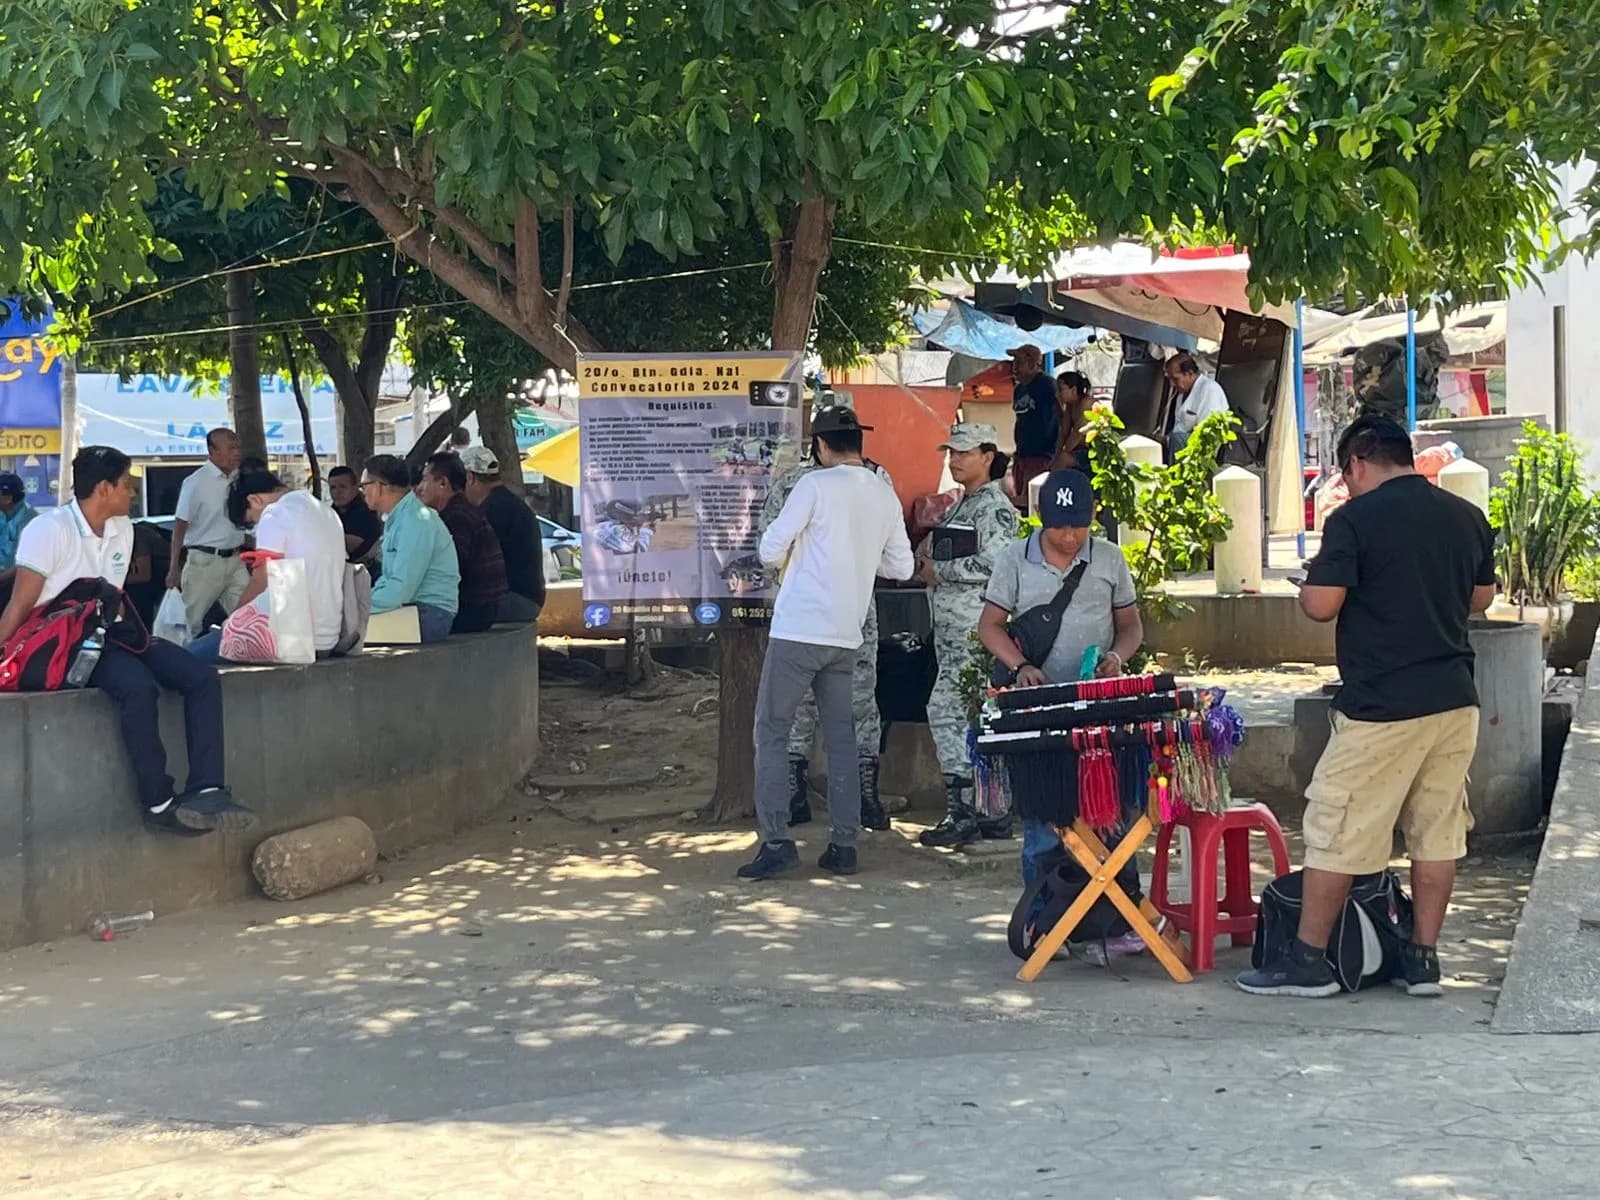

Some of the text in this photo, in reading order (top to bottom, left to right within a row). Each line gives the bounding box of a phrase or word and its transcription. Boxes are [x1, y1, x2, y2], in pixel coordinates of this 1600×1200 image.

[0, 338, 61, 374] ay
[591, 380, 740, 393] Convocatoria 2024
[167, 423, 208, 439] LA
[1056, 487, 1073, 506] NY
